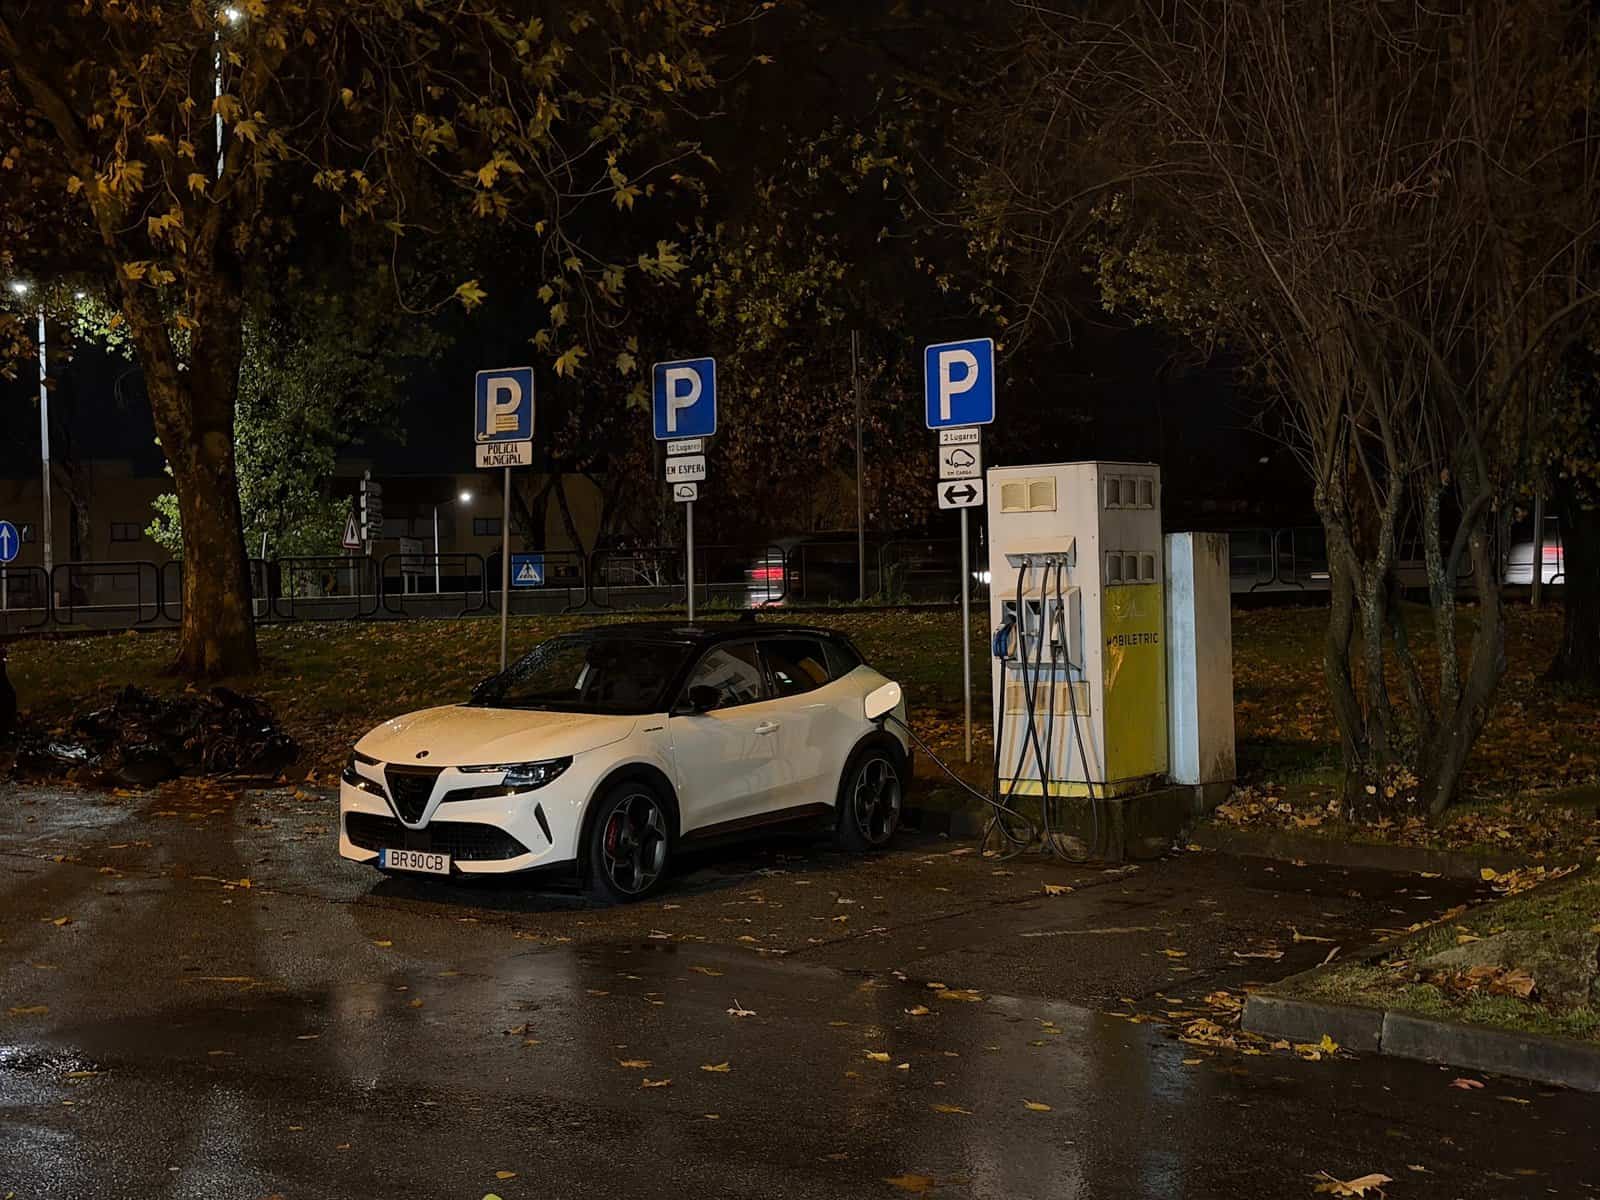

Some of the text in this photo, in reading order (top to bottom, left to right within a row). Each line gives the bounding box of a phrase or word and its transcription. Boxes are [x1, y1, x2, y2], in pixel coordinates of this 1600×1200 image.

[665, 367, 702, 432] P
[938, 349, 979, 420] P
[486, 377, 522, 435] P
[943, 433, 949, 442] 2
[482, 453, 523, 466] MUNICIPAL
[1106, 632, 1159, 647] MOBILETRIC
